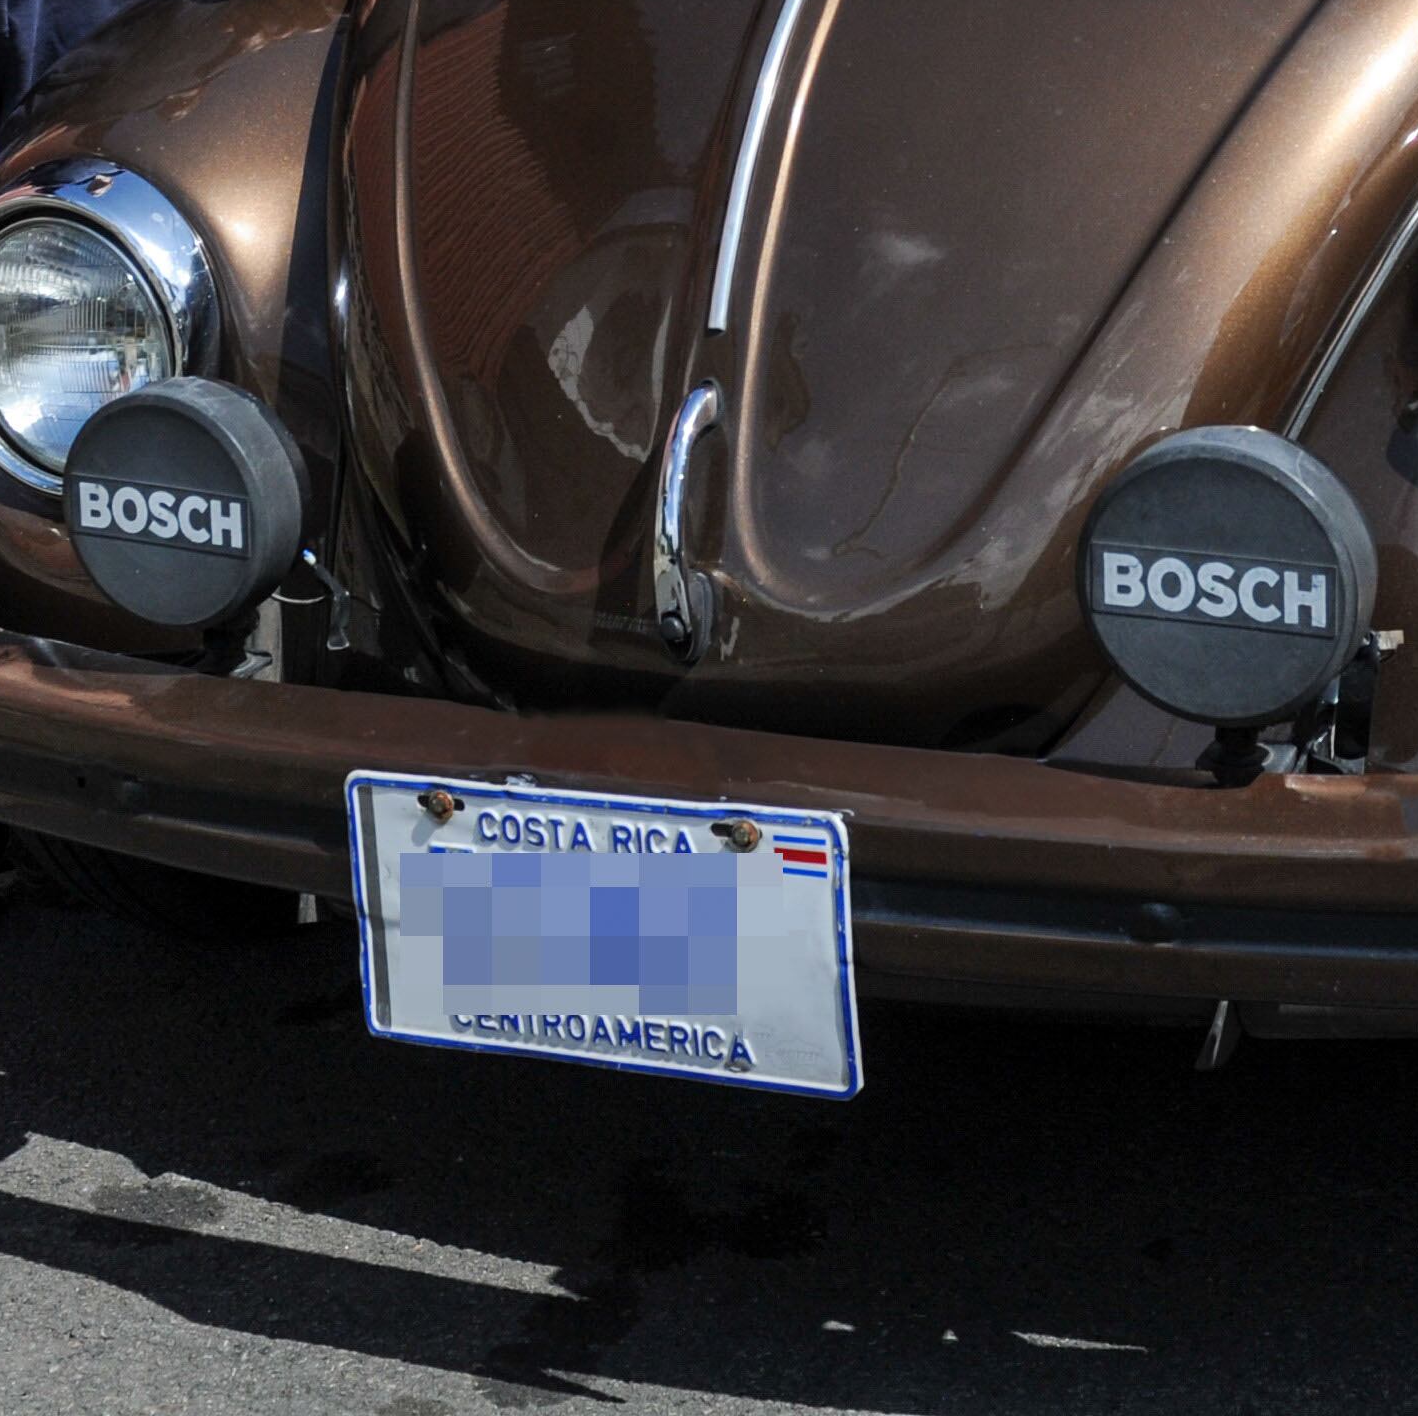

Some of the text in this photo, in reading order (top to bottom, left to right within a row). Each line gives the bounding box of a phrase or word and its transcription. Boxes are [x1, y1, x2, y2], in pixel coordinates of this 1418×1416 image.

[79, 482, 242, 549] BOSCH
[1103, 552, 1327, 628] BOSCH
[479, 811, 694, 853] COSTA RICA
